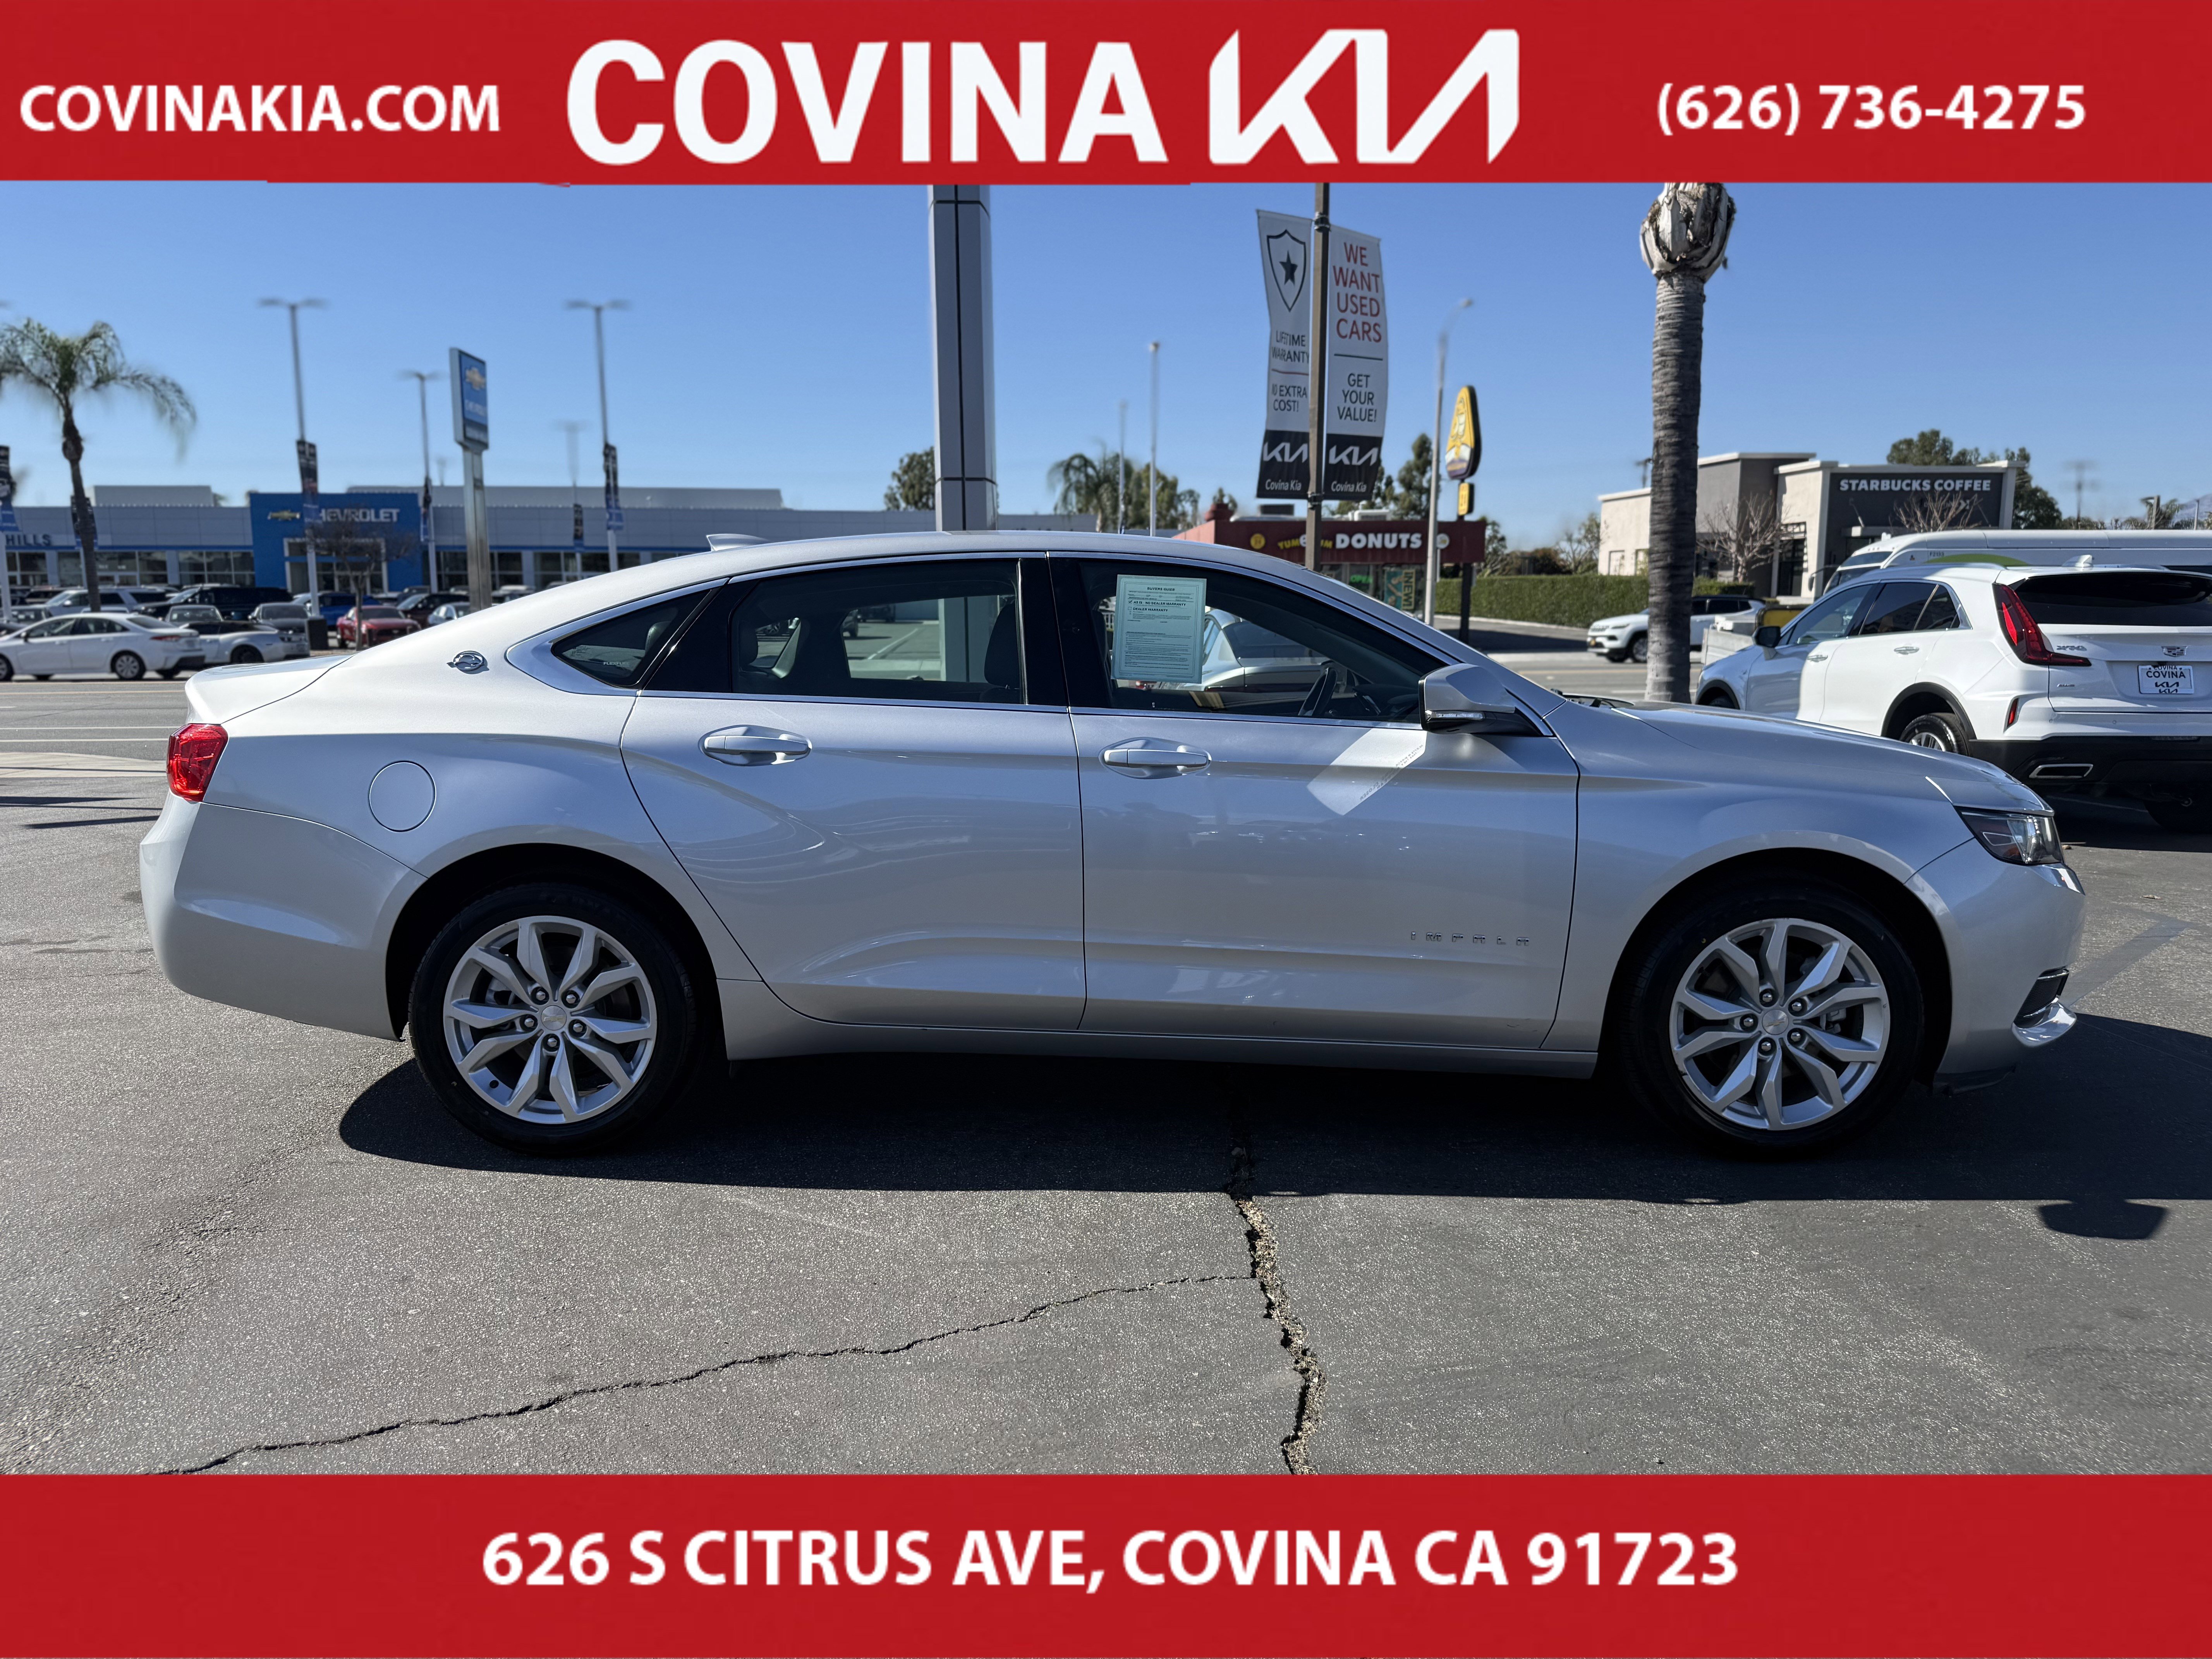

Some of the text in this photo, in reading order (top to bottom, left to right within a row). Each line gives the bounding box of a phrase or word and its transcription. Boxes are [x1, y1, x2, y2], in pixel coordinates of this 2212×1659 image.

[1343, 242, 1369, 267] WE
[1333, 265, 1380, 293] WANT
[1337, 292, 1380, 318] USED
[1336, 318, 1382, 343] CARS
[1347, 373, 1370, 388] GET
[1279, 385, 1307, 399] EXTRA
[1342, 389, 1374, 405] YOUR
[1273, 399, 1299, 412] COST!
[1337, 406, 1377, 422] VALUE!
[1265, 479, 1302, 491] Covina Kia
[1331, 481, 1367, 493] Covina Kia
[1840, 479, 1991, 491] STARBUCKS COFFEE
[319, 508, 400, 522] HEVROLET
[5, 534, 52, 546] HILLS
[1336, 532, 1422, 549] DONUTS
[1411, 931, 1530, 946] IMPALA
